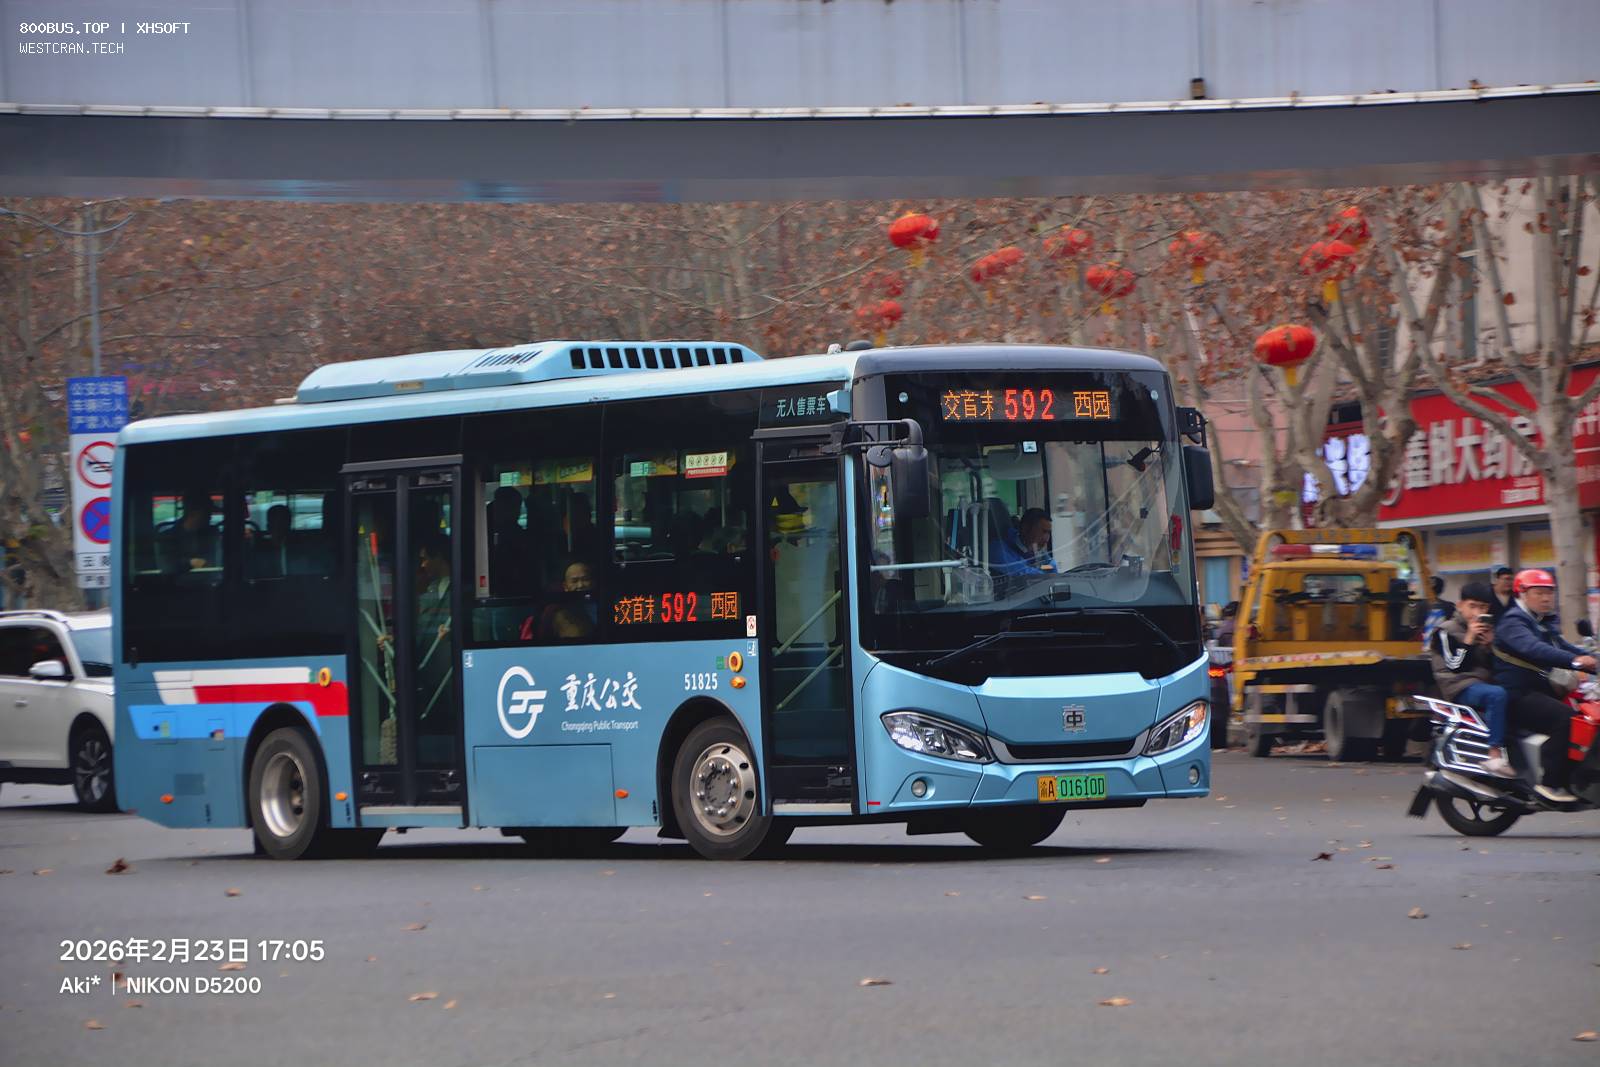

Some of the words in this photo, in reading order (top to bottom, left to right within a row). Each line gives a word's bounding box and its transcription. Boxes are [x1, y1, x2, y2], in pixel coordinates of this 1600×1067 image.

[776, 395, 826, 417] 无人售票车
[1004, 388, 1055, 420] 592
[1073, 391, 1111, 419] 西园
[661, 591, 697, 623] 592
[710, 591, 738, 620] 西园
[560, 671, 642, 712] 重庆公交
[684, 672, 718, 691] 51825
[561, 721, 593, 733] Chongqing
[593, 720, 611, 731] Public
[611, 719, 639, 732] Transport
